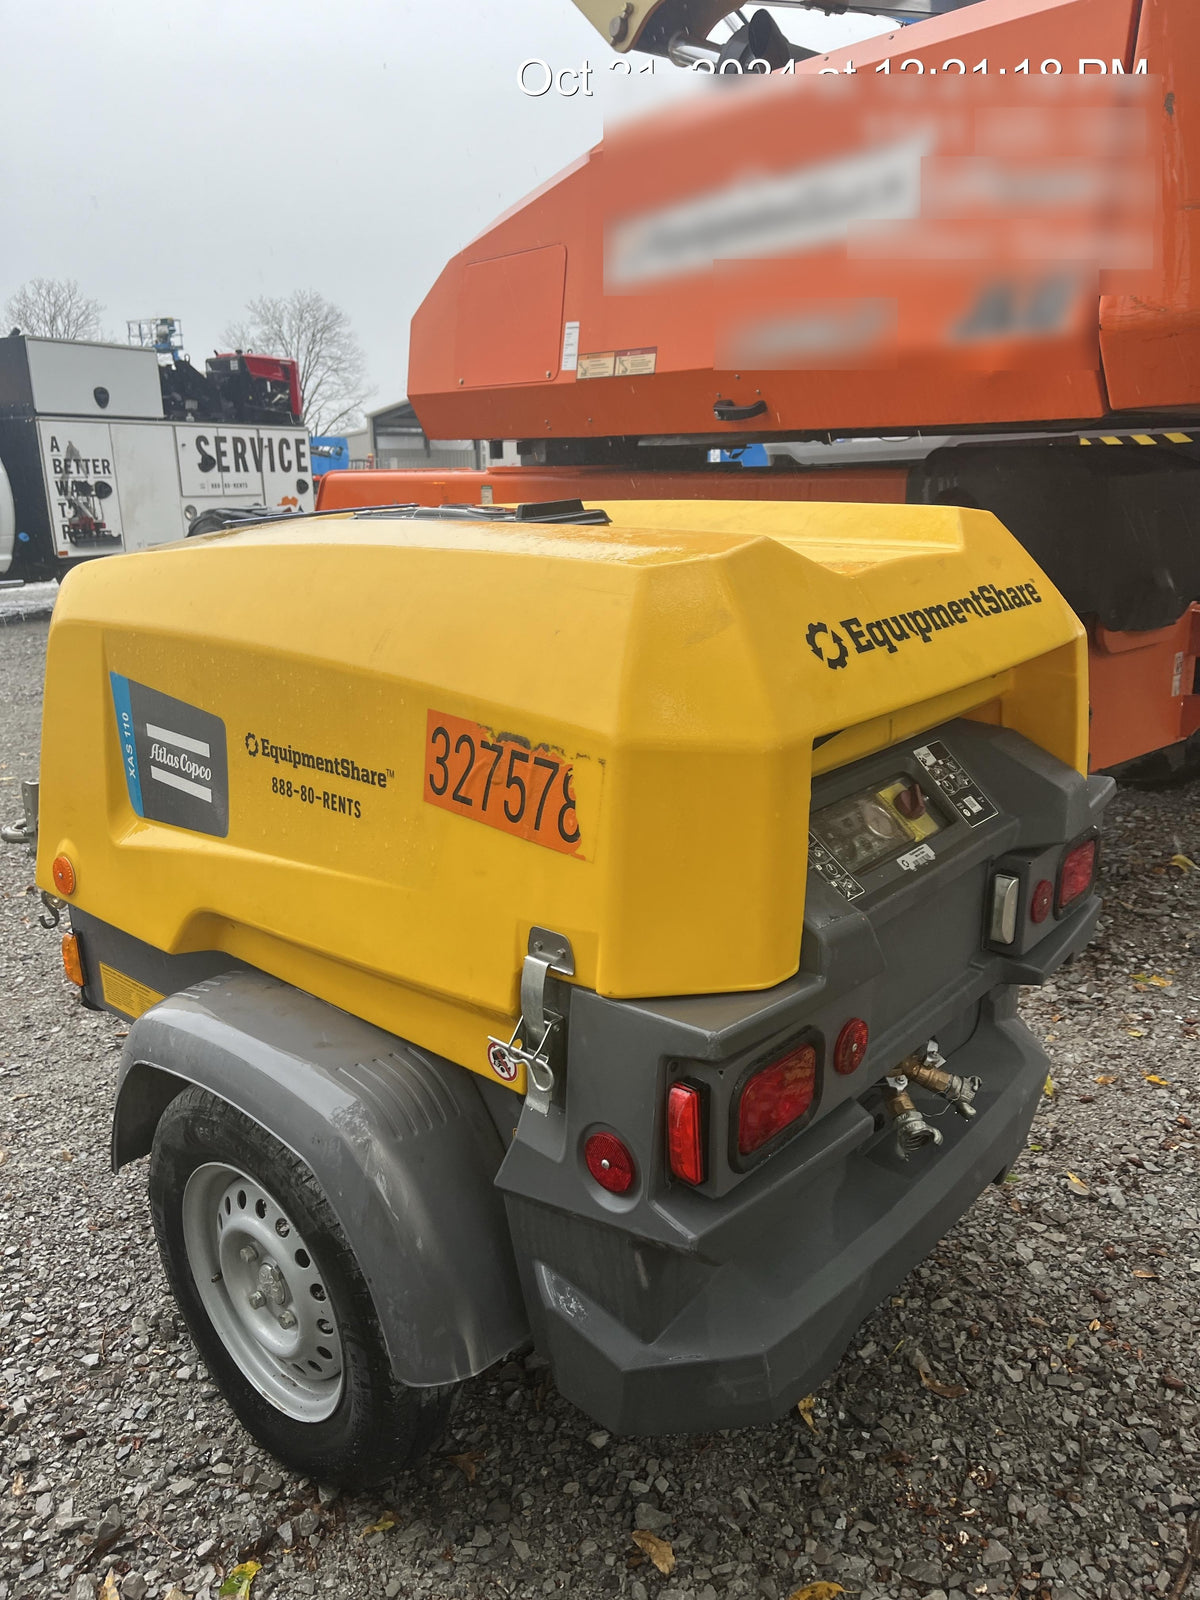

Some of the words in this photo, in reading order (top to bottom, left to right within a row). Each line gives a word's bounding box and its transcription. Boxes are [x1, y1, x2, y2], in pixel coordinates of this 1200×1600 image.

[50, 435, 60, 453] A
[195, 435, 309, 473] SERVICE
[52, 458, 112, 475] BETTER
[121, 711, 131, 737] 110
[125, 744, 137, 779] XAS
[271, 776, 361, 819] 888-80-RENTS
[429, 726, 581, 843] 327578
